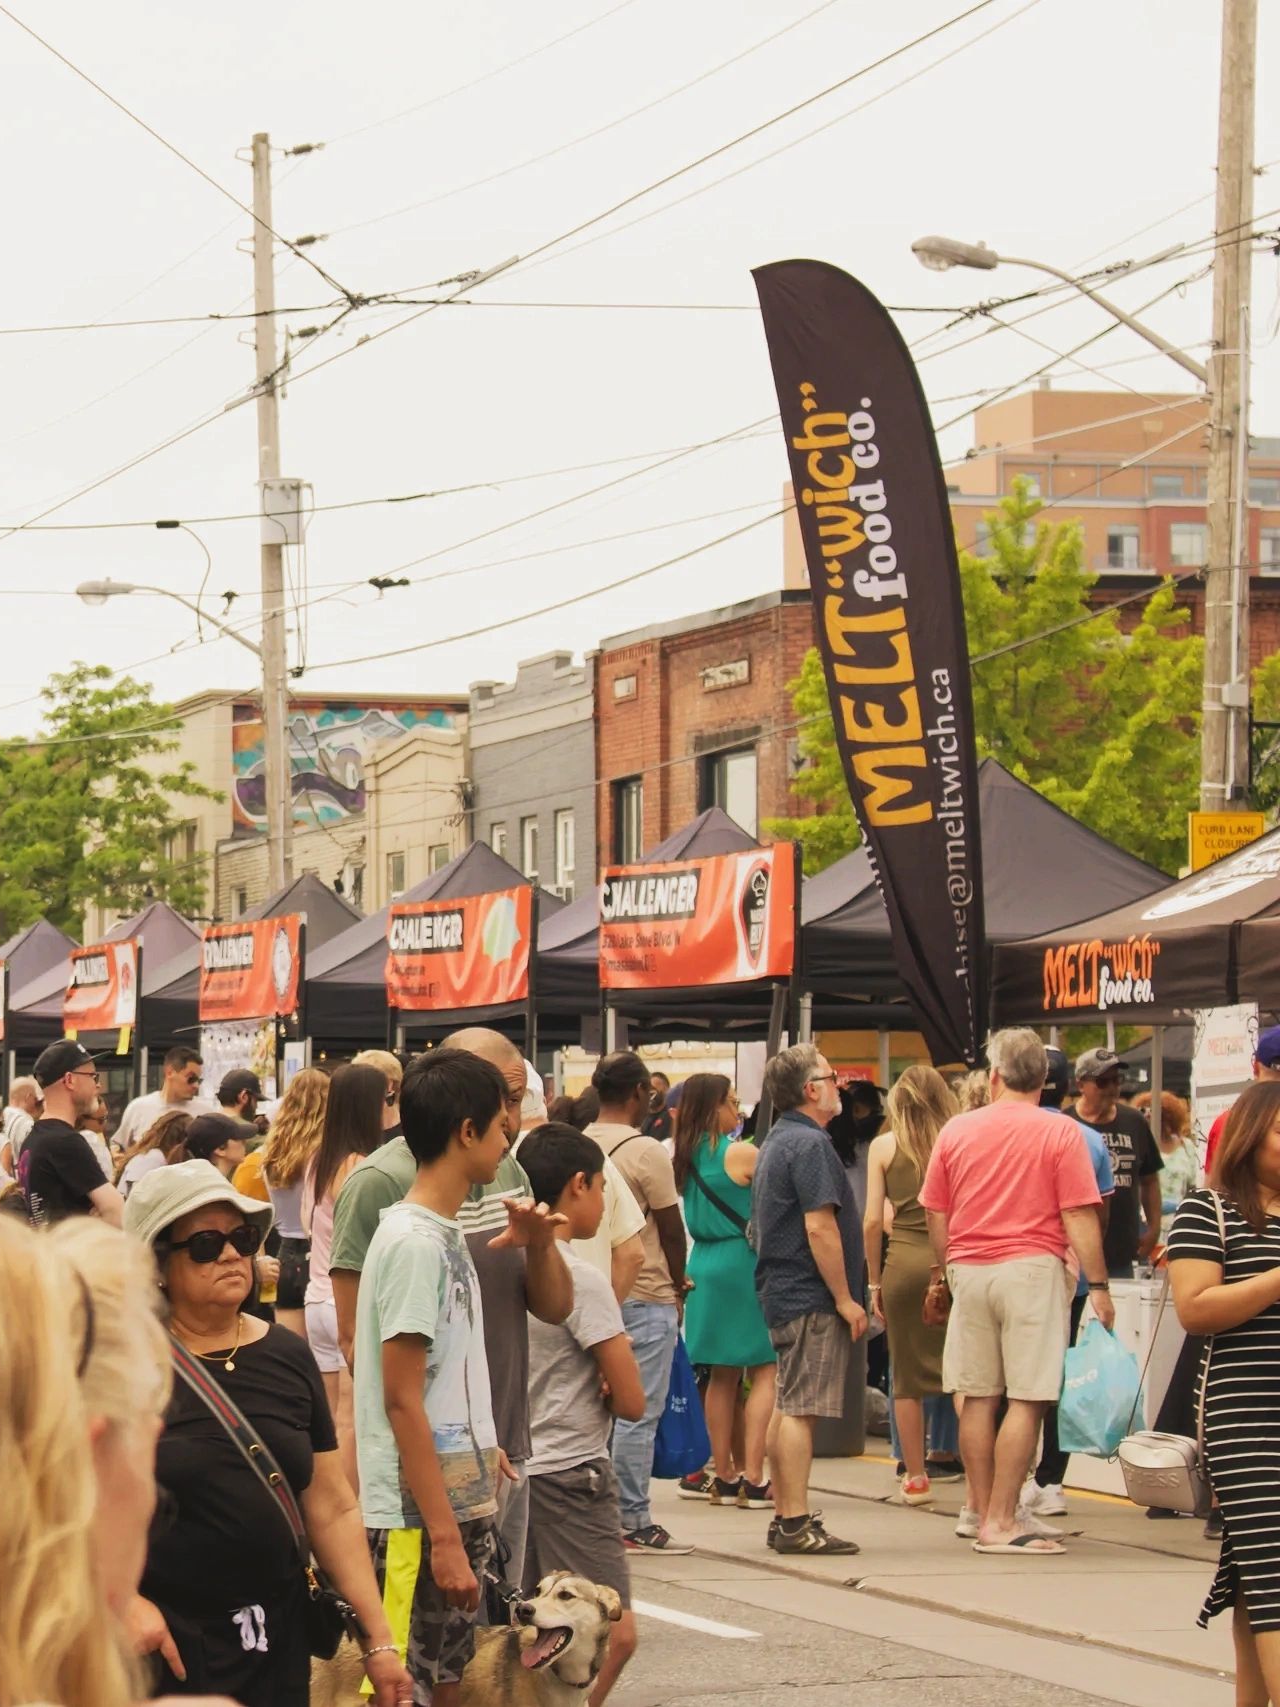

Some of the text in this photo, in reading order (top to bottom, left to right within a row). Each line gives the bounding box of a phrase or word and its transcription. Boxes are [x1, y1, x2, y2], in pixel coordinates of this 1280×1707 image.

[847, 397, 909, 602] food co.
[1198, 823, 1257, 836] CURB LANE
[927, 668, 977, 1062] hise@meltwich.ca
[389, 912, 464, 950] CHALENGER
[1098, 965, 1155, 1010] food co.
